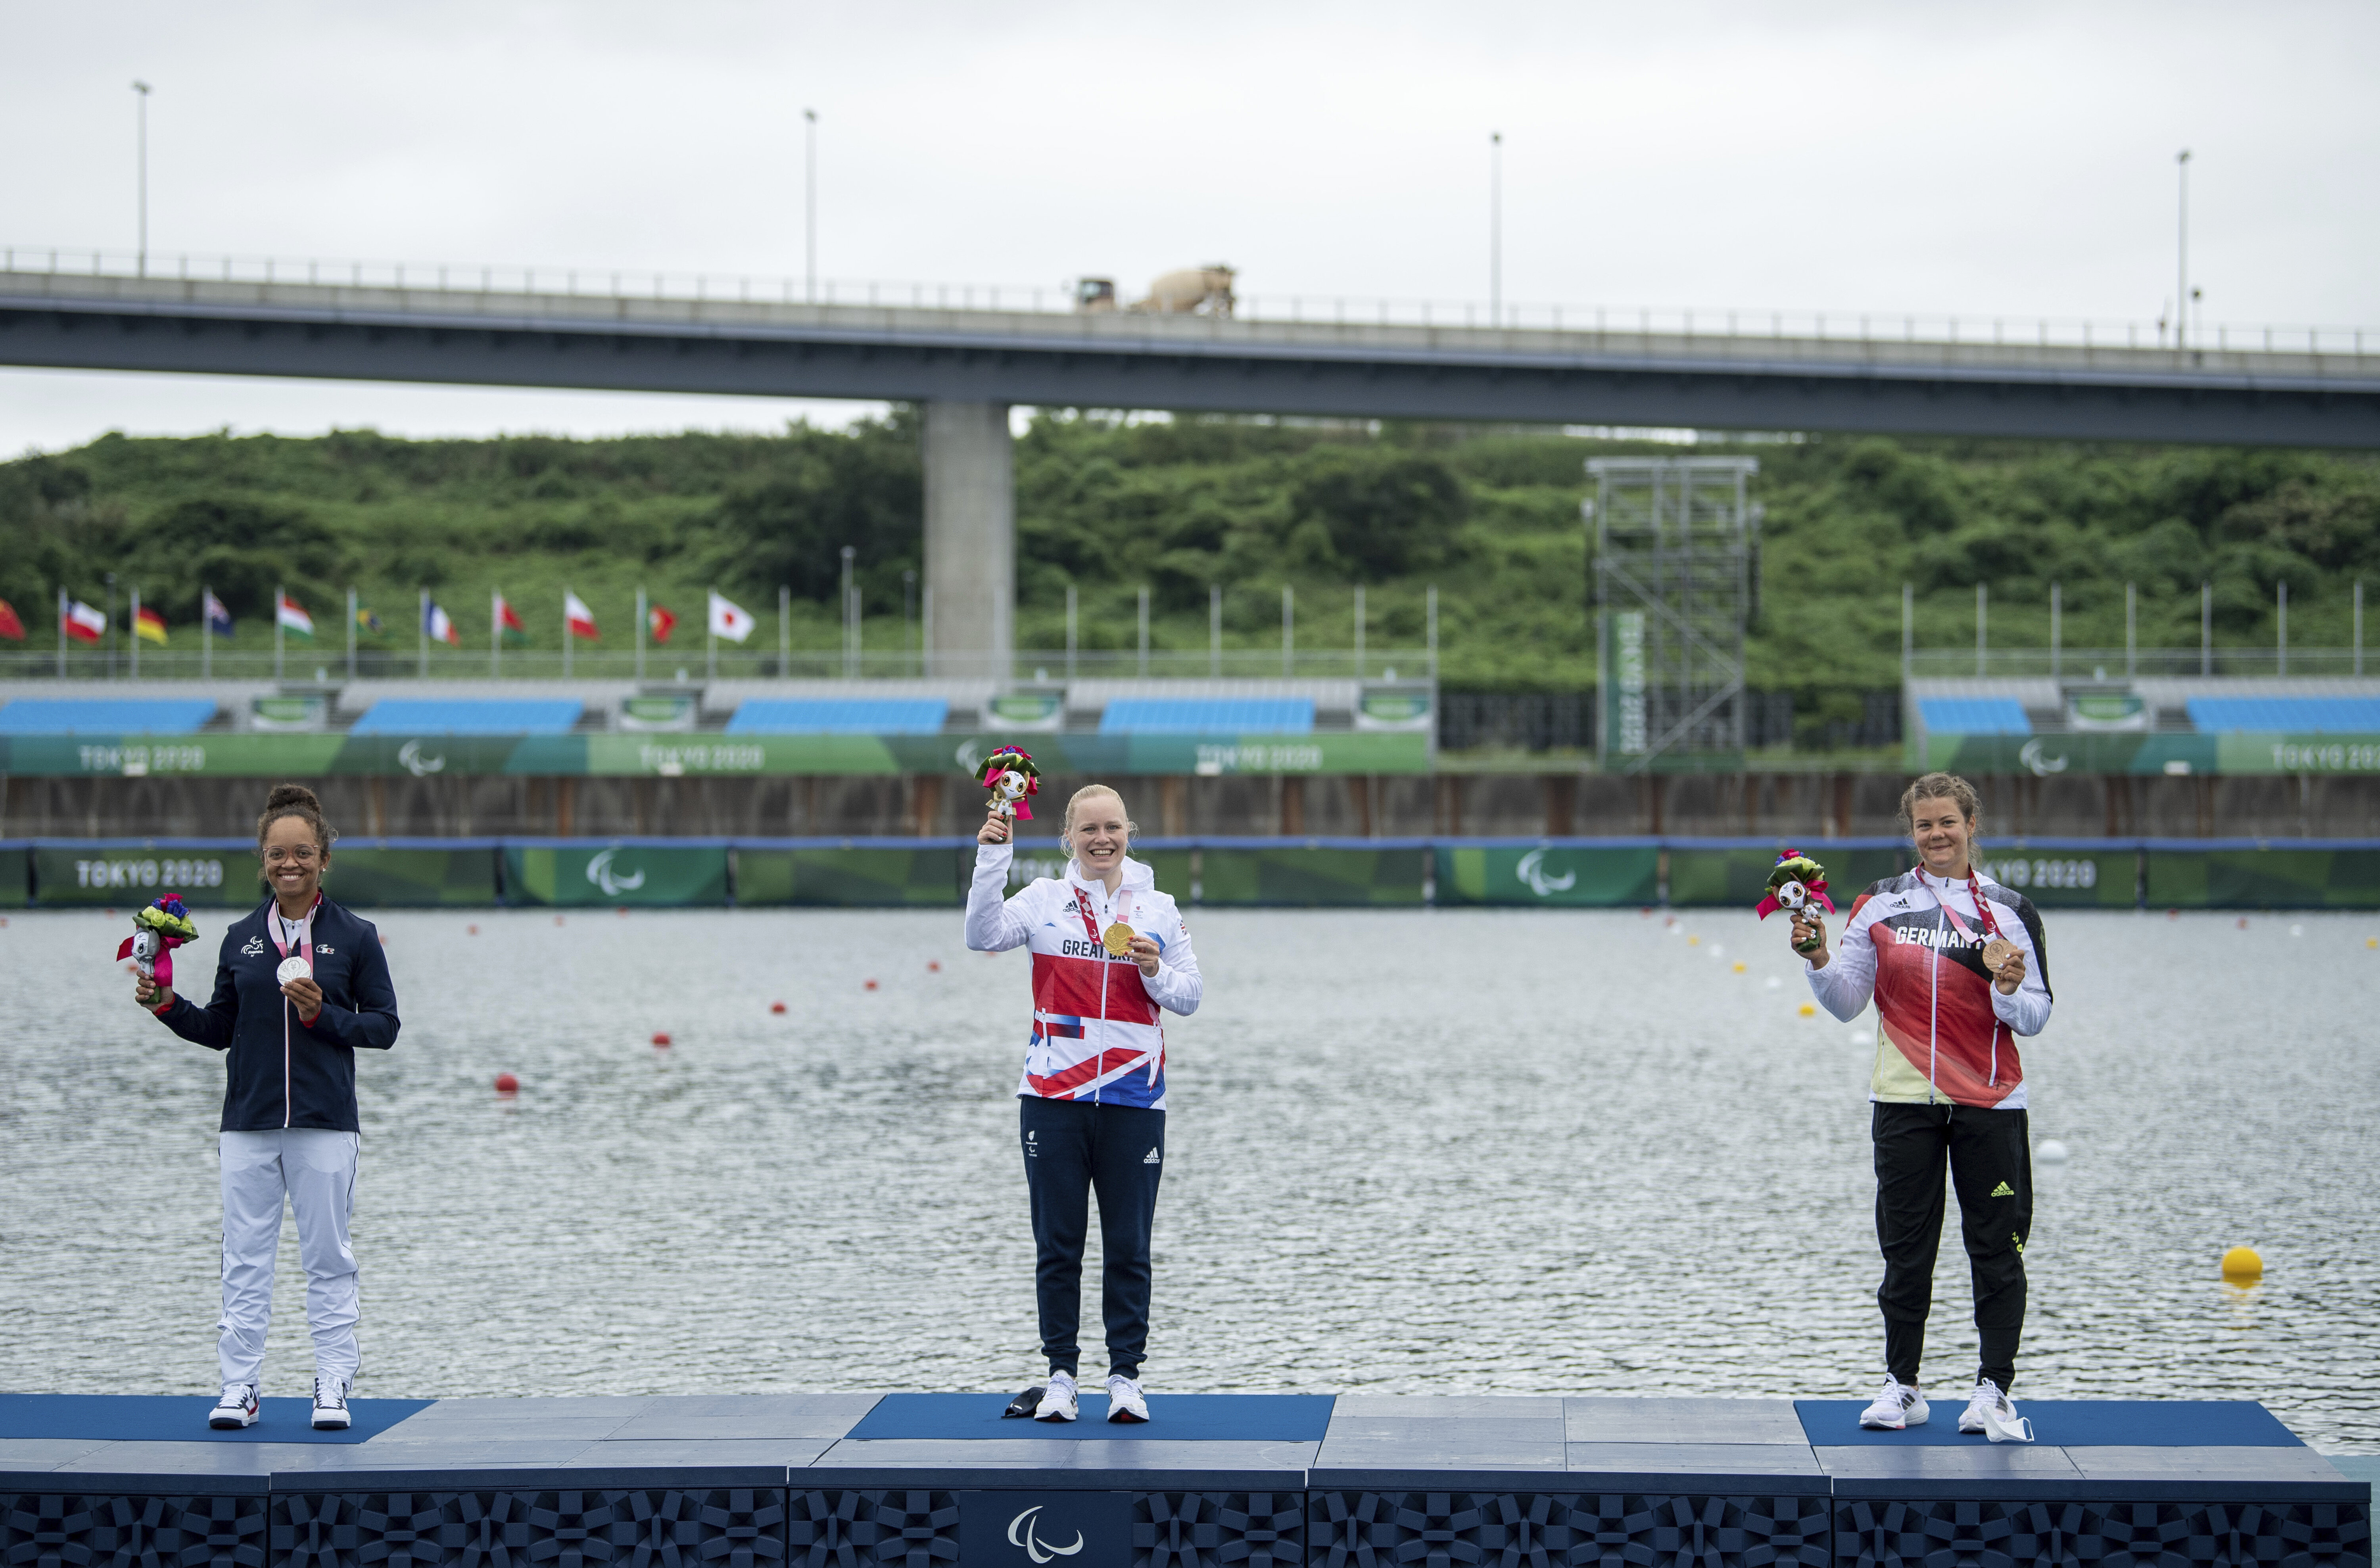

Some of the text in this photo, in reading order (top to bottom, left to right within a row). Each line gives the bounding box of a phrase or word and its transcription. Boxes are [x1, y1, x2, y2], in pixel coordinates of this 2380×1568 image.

[2272, 743, 2345, 770] TOKYO
[75, 858, 223, 888] TOKYO 2020
[2033, 859, 2097, 888] 2020
